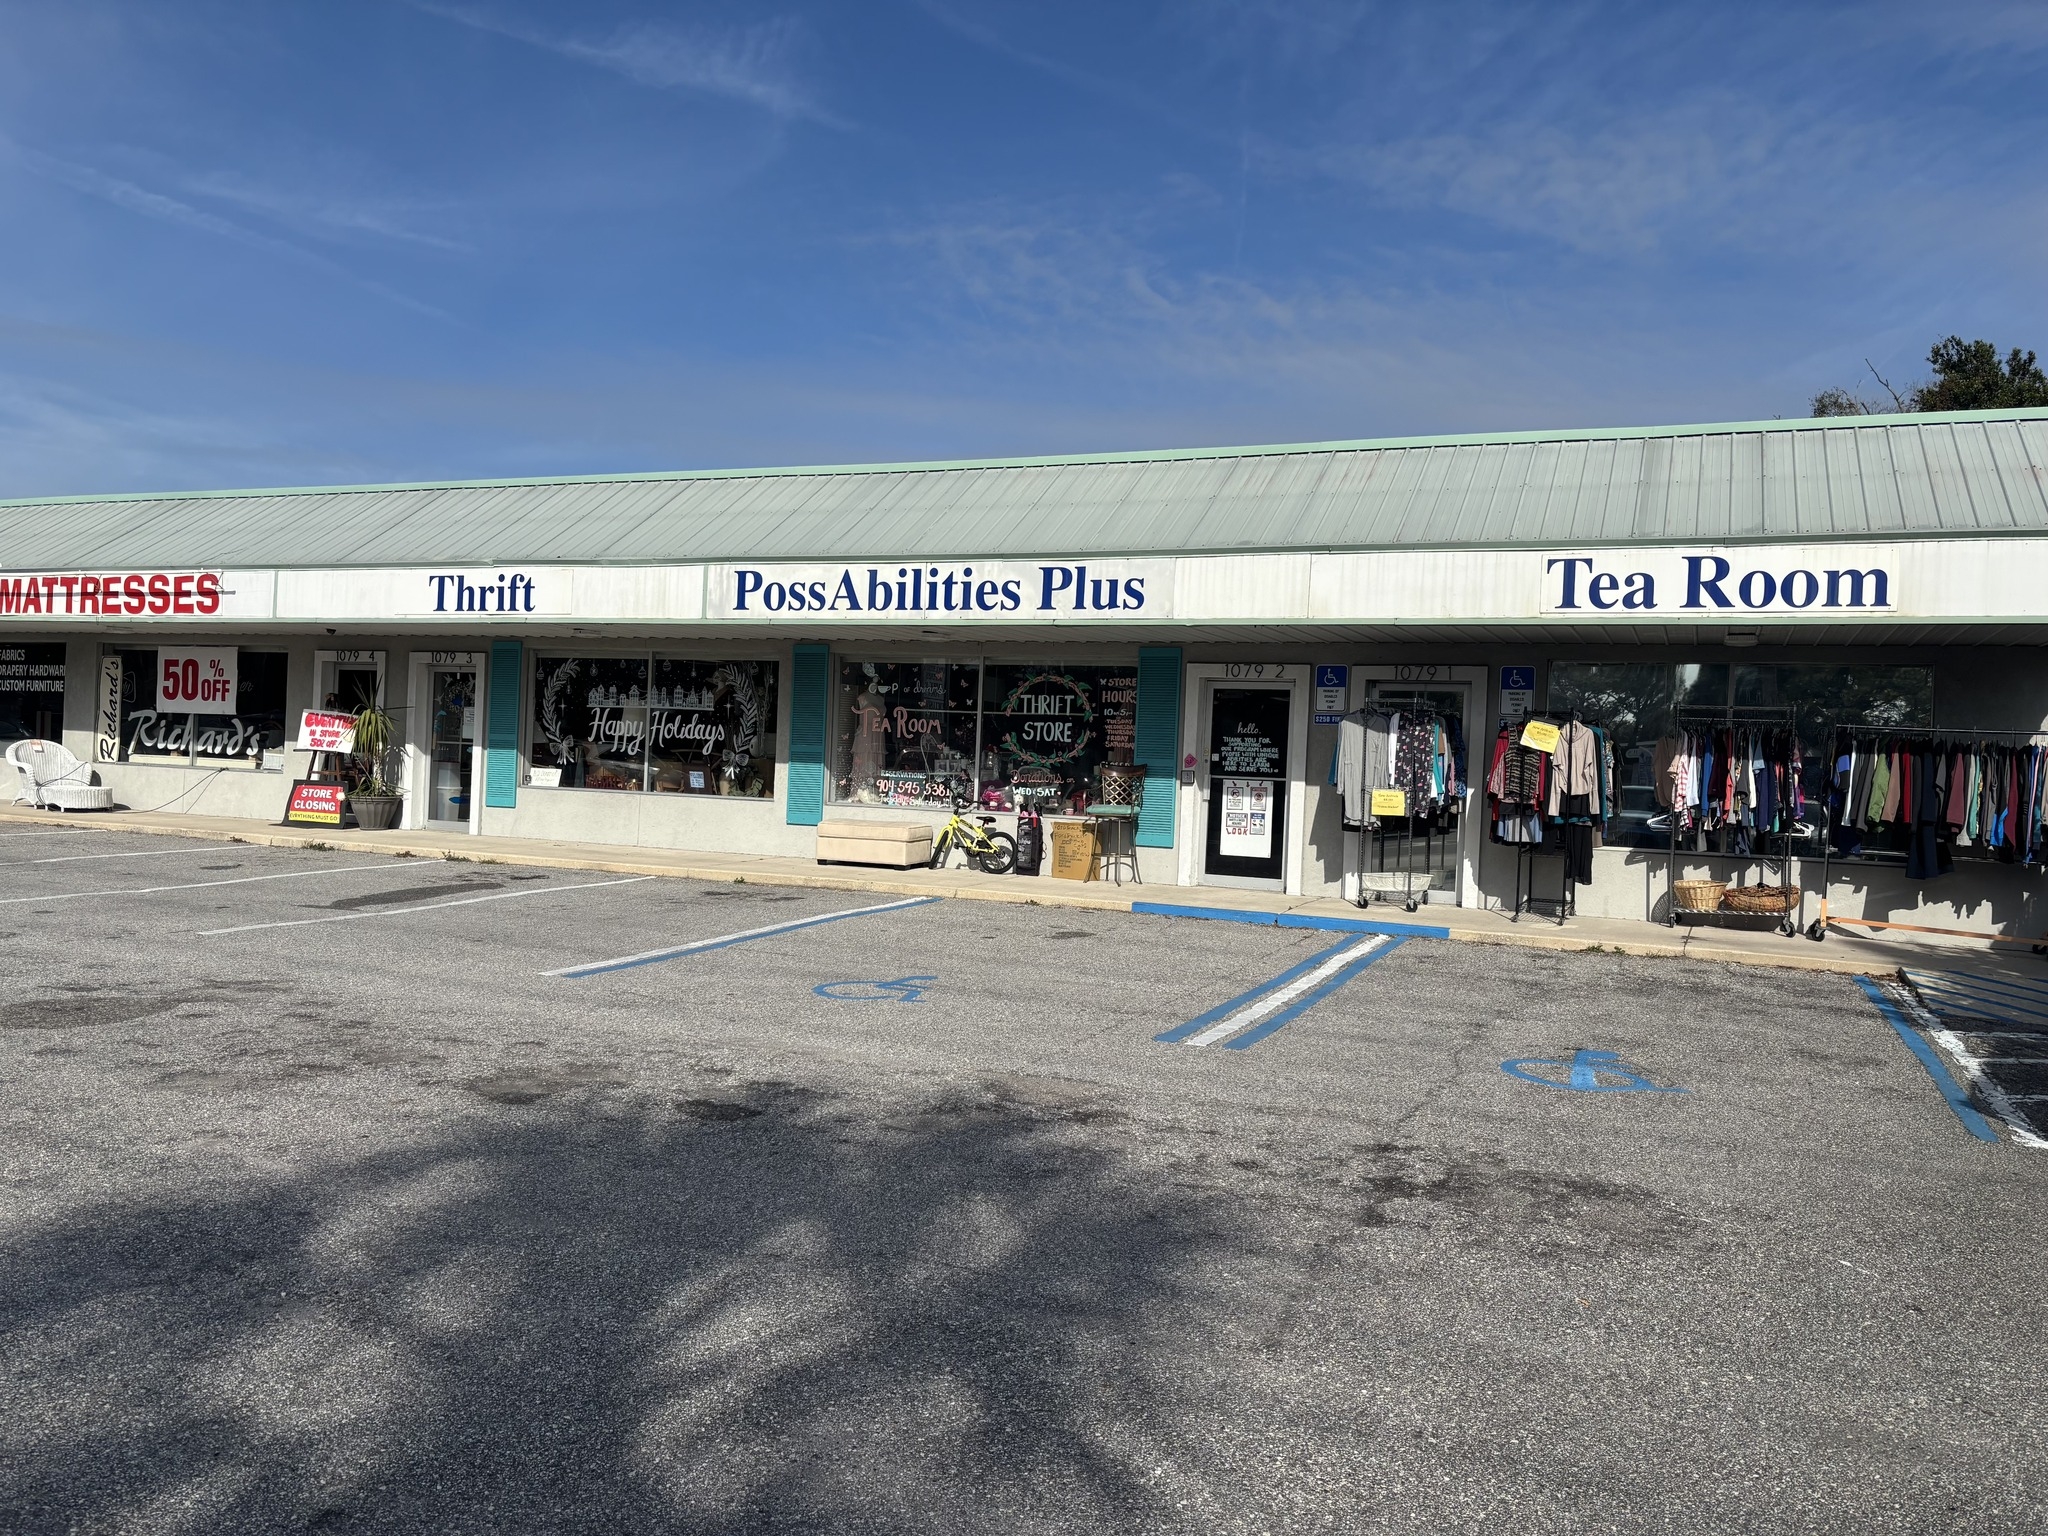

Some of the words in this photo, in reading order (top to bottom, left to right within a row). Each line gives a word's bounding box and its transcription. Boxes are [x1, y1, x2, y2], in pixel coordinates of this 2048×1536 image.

[732, 567, 1022, 612] PossAbilities
[1036, 566, 1146, 611] Plus
[1547, 557, 1658, 609] Tea
[1680, 556, 1892, 609] Room
[0, 573, 220, 614] MATTRESSES
[428, 573, 536, 613] Thrift
[336, 650, 360, 661] 1079
[368, 651, 375, 662] 4
[431, 652, 456, 664] 1079
[466, 652, 473, 664] 3
[162, 658, 199, 701] 50
[1224, 663, 1265, 679] 1079
[1275, 665, 1286, 679] 2
[1393, 664, 1438, 682] 1079
[26, 680, 64, 692] FURNITURE
[200, 678, 231, 702] OFF
[1107, 677, 1138, 687] STORE
[100, 658, 120, 762] Richard's
[1020, 694, 1075, 716] THRIFT
[1315, 715, 1331, 723] $250
[128, 708, 261, 757] Richard's
[587, 707, 646, 756] Happy
[648, 710, 726, 756] Holidays
[1022, 721, 1073, 743] STORE
[880, 769, 927, 779] RESERVATIONS
[1010, 769, 1065, 784] Donations
[300, 787, 334, 799] STORE
[1012, 786, 1032, 796] WED
[1036, 787, 1057, 797] SAT
[294, 800, 336, 811] CLOSING
[1225, 827, 1249, 836] LOOK
